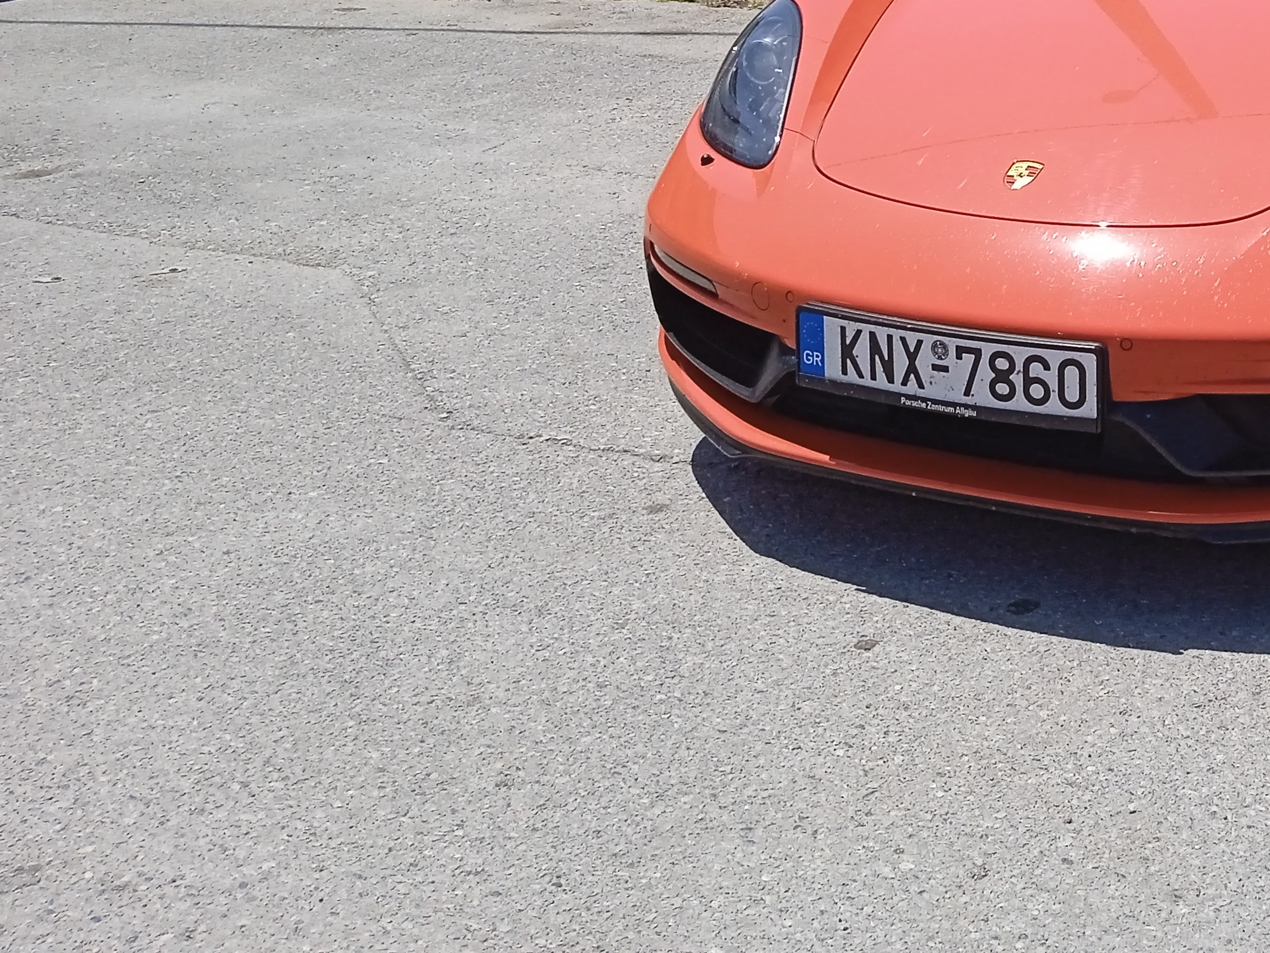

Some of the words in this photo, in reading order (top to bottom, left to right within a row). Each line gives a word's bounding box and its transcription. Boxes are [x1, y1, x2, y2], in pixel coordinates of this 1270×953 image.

[803, 350, 822, 367] GR
[900, 396, 927, 409] Porsche
[926, 401, 955, 414] Zentrum
